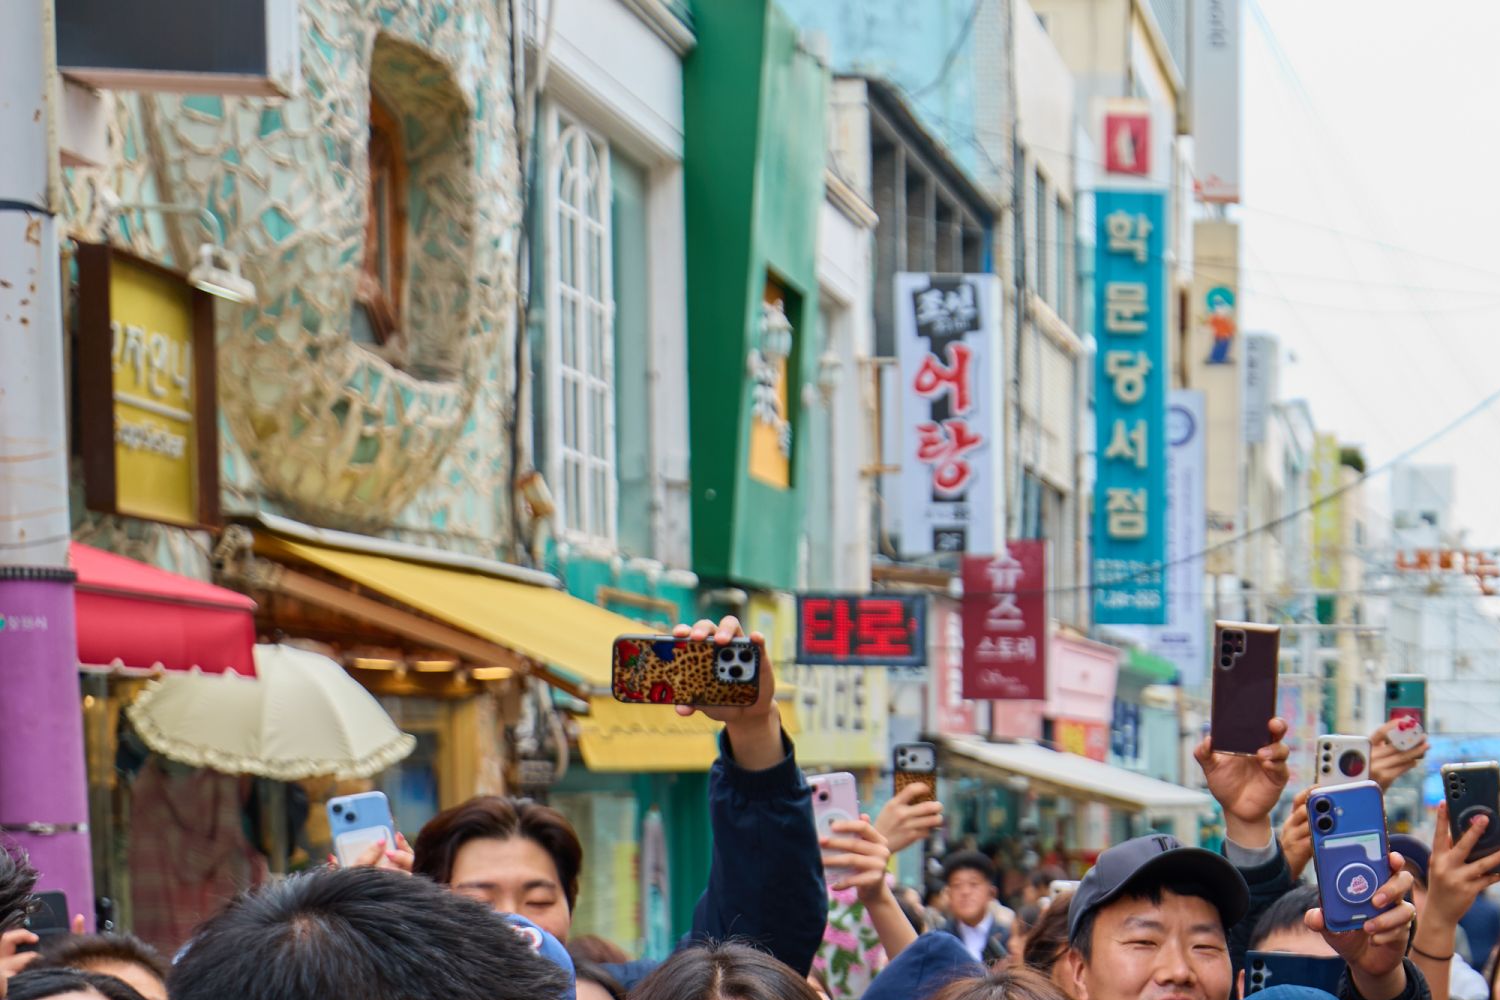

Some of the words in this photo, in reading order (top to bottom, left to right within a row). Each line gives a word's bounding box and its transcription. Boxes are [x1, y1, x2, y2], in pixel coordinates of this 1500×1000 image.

[913, 343, 981, 494] 어탕
[1103, 209, 1153, 540] 학문당서점
[803, 598, 912, 660] 타로
